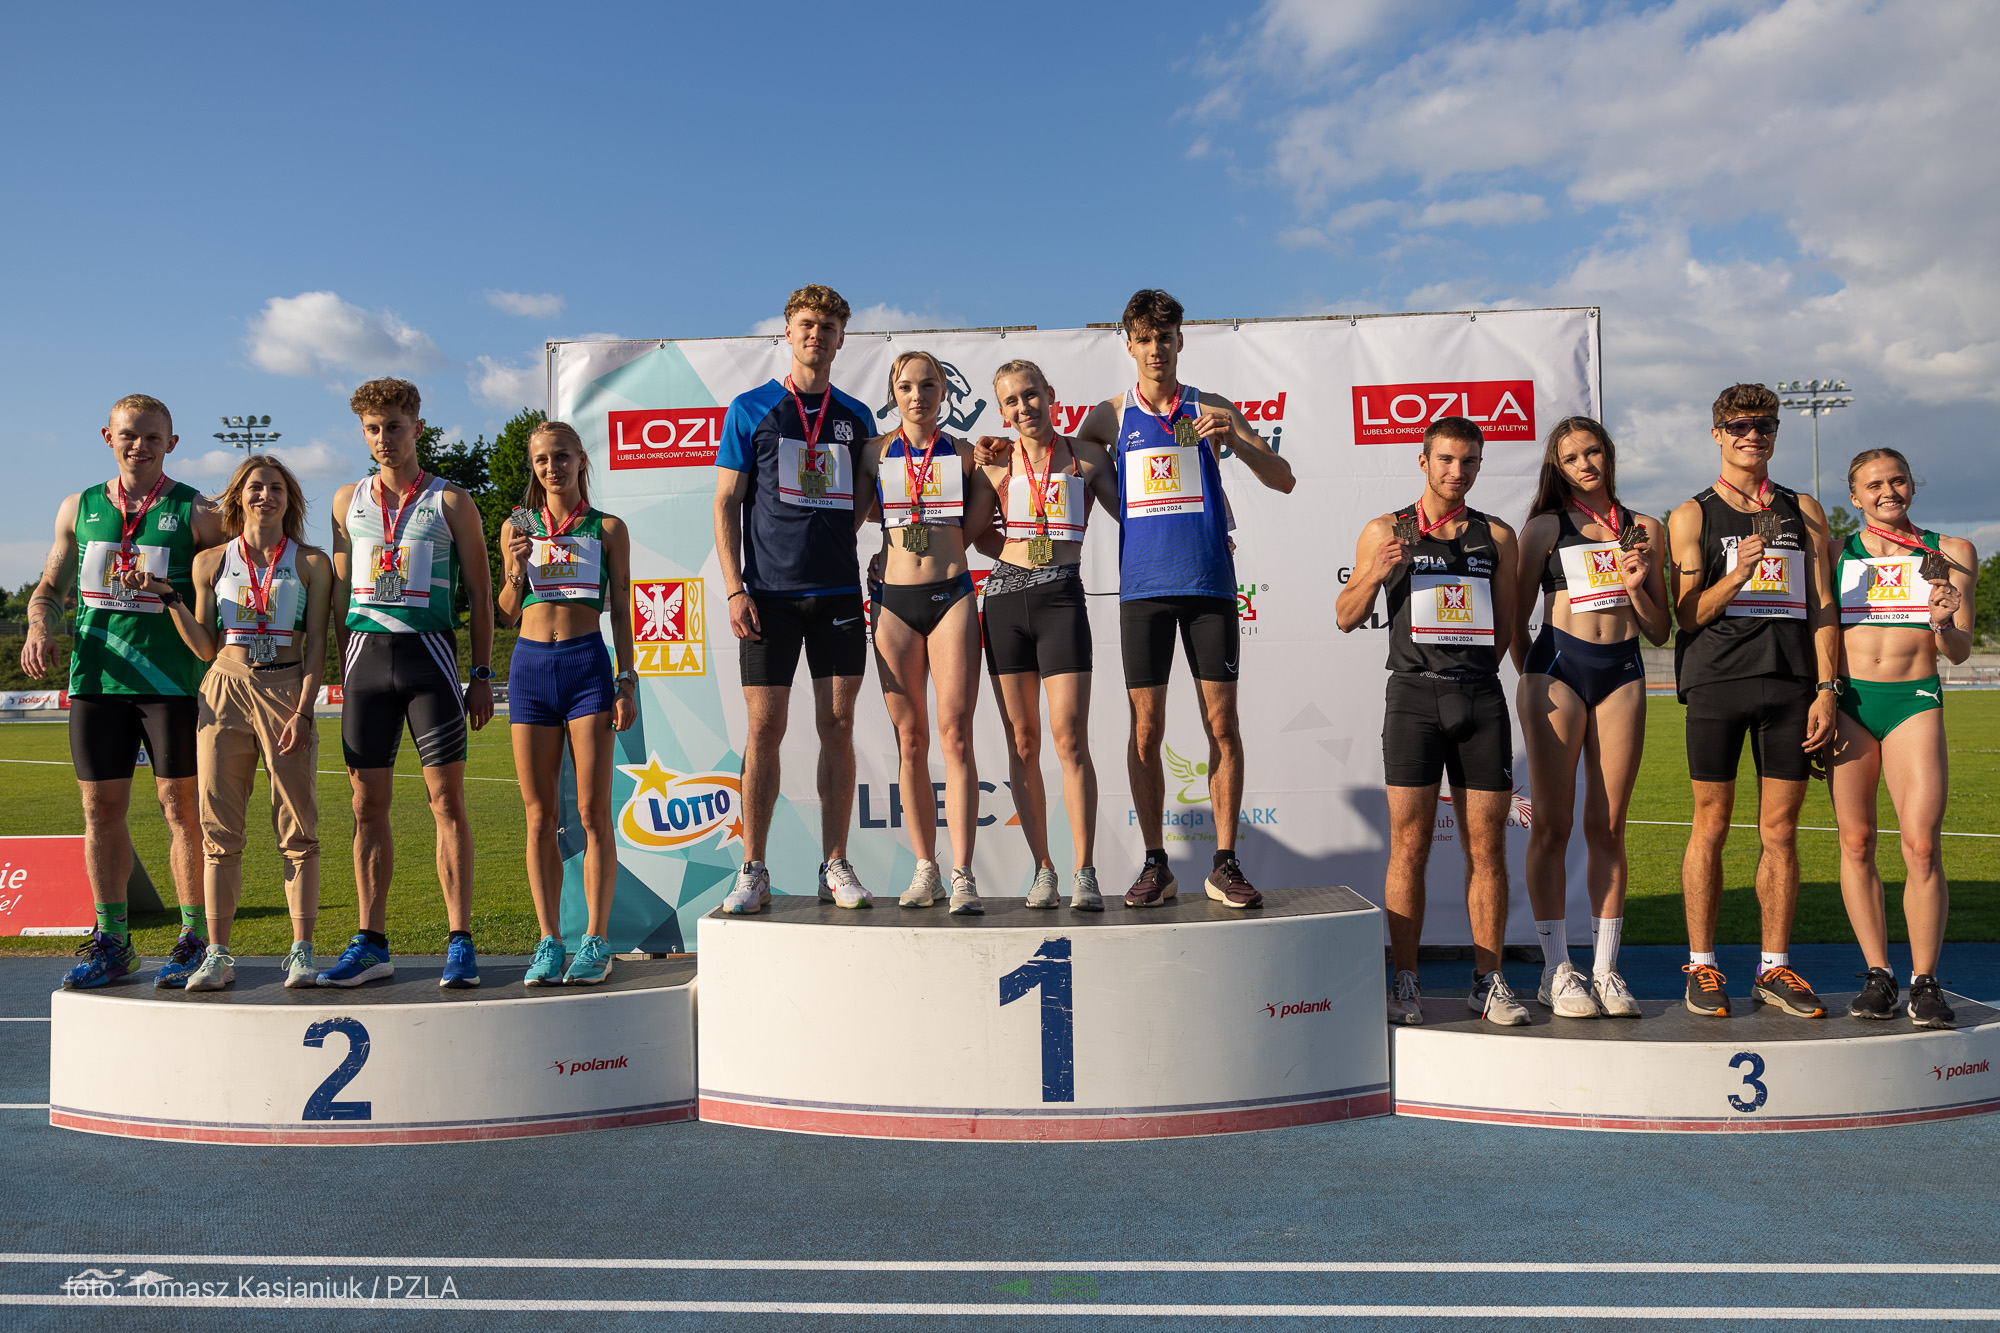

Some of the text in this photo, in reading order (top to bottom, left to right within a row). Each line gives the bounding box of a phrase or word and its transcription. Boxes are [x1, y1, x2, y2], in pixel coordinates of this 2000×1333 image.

[1362, 390, 1528, 425] LOZLA
[616, 418, 720, 450] LOZL
[1396, 428, 1427, 436] OKRĘGO
[1147, 480, 1178, 492] PZLA
[1032, 505, 1063, 515] PLA
[543, 567, 575, 576] PZLA
[1591, 574, 1624, 586] PZLA
[1754, 583, 1787, 593] PZLA
[1870, 588, 1907, 598] PZLA
[239, 611, 272, 621] PZA
[1439, 610, 1470, 620] PZLA
[648, 790, 730, 831] LOTTO
[1128, 808, 1278, 828] Fdacja ARK
[1280, 998, 1332, 1018] polanik
[999, 936, 1074, 1102] 1
[302, 1016, 372, 1120] 2
[570, 1055, 629, 1076] polanik
[1946, 1059, 1990, 1081] polanik
[1727, 1051, 1768, 1113] 3
